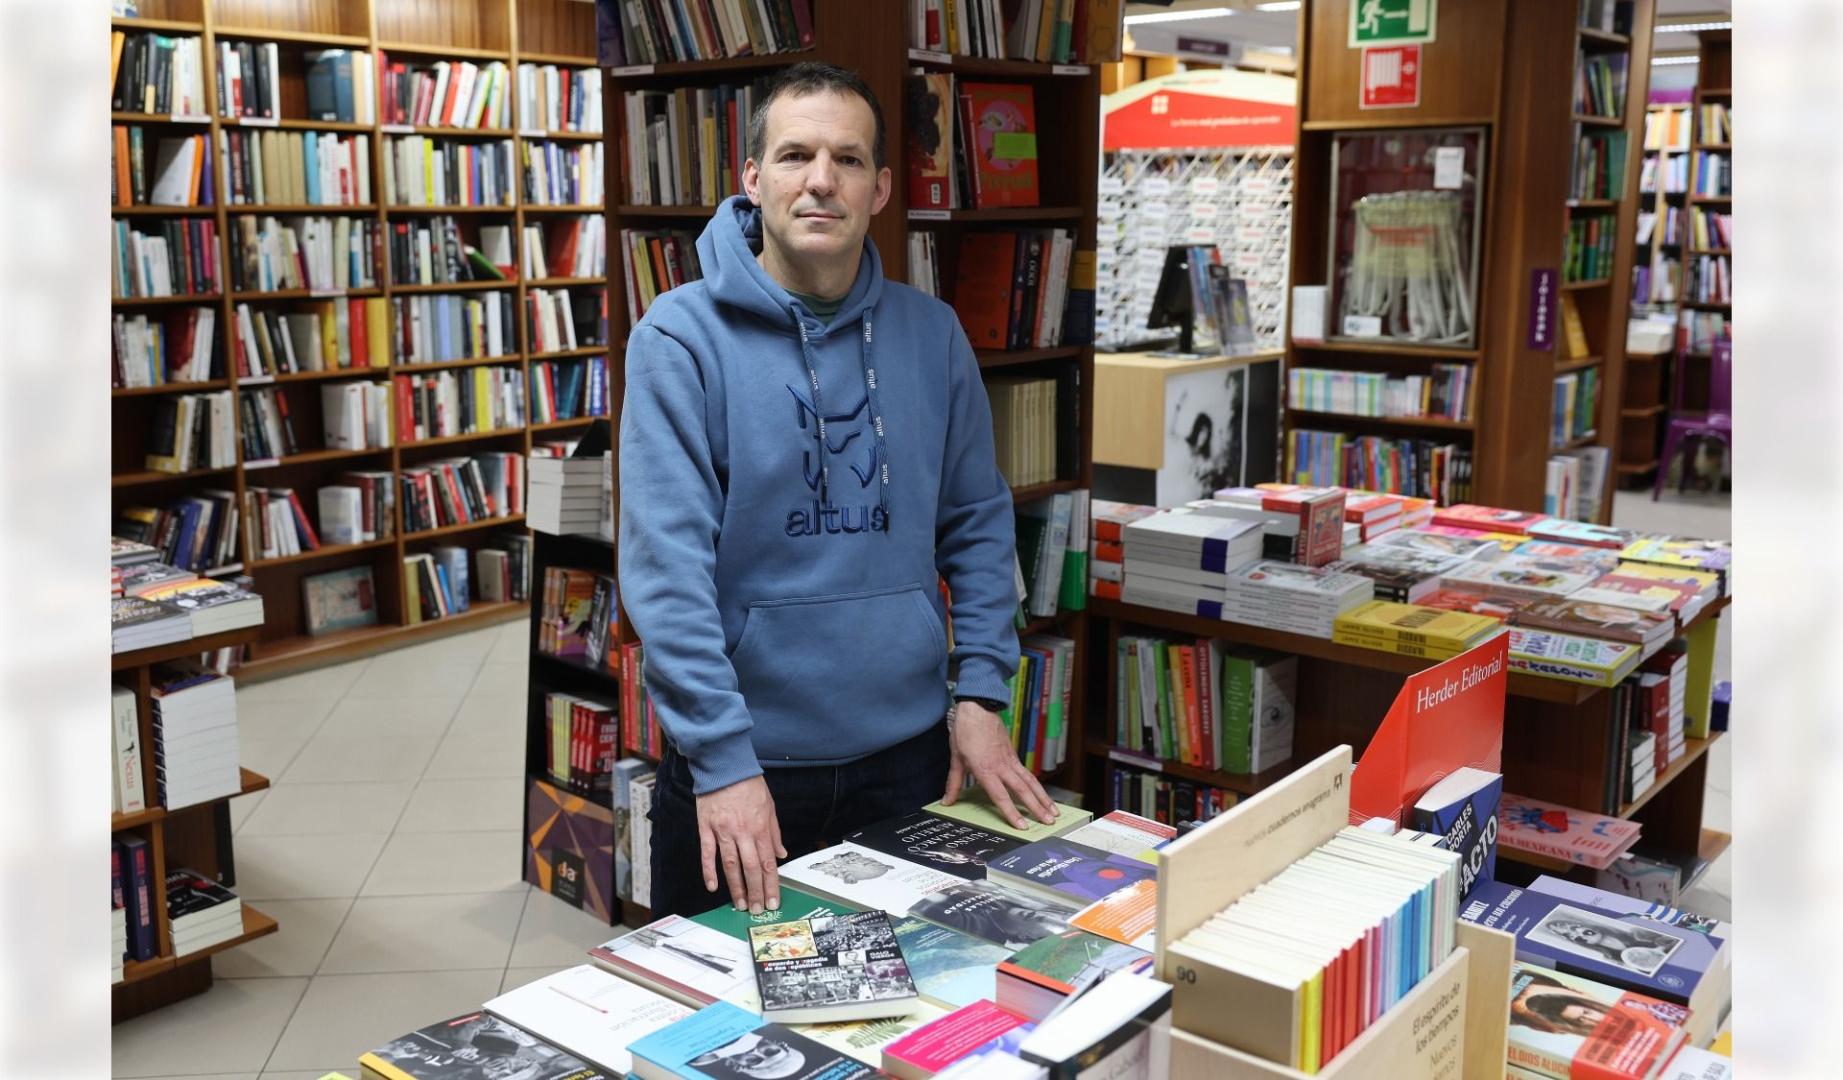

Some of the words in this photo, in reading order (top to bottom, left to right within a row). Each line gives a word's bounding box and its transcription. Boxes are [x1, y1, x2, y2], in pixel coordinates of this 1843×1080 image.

[868, 368, 876, 390] altus
[876, 416, 884, 437] altus
[785, 498, 887, 537] altus
[1416, 678, 1458, 713] Herder
[1461, 648, 1503, 692] Editorial
[1446, 803, 1473, 844] CARLES
[907, 832, 956, 853] MARCO
[1449, 820, 1472, 851] PORTA
[1515, 836, 1572, 859] MEXICANA
[1176, 966, 1196, 985] 90
[1429, 1004, 1459, 1042] tiempos
[1519, 1049, 1539, 1067] DIOS
